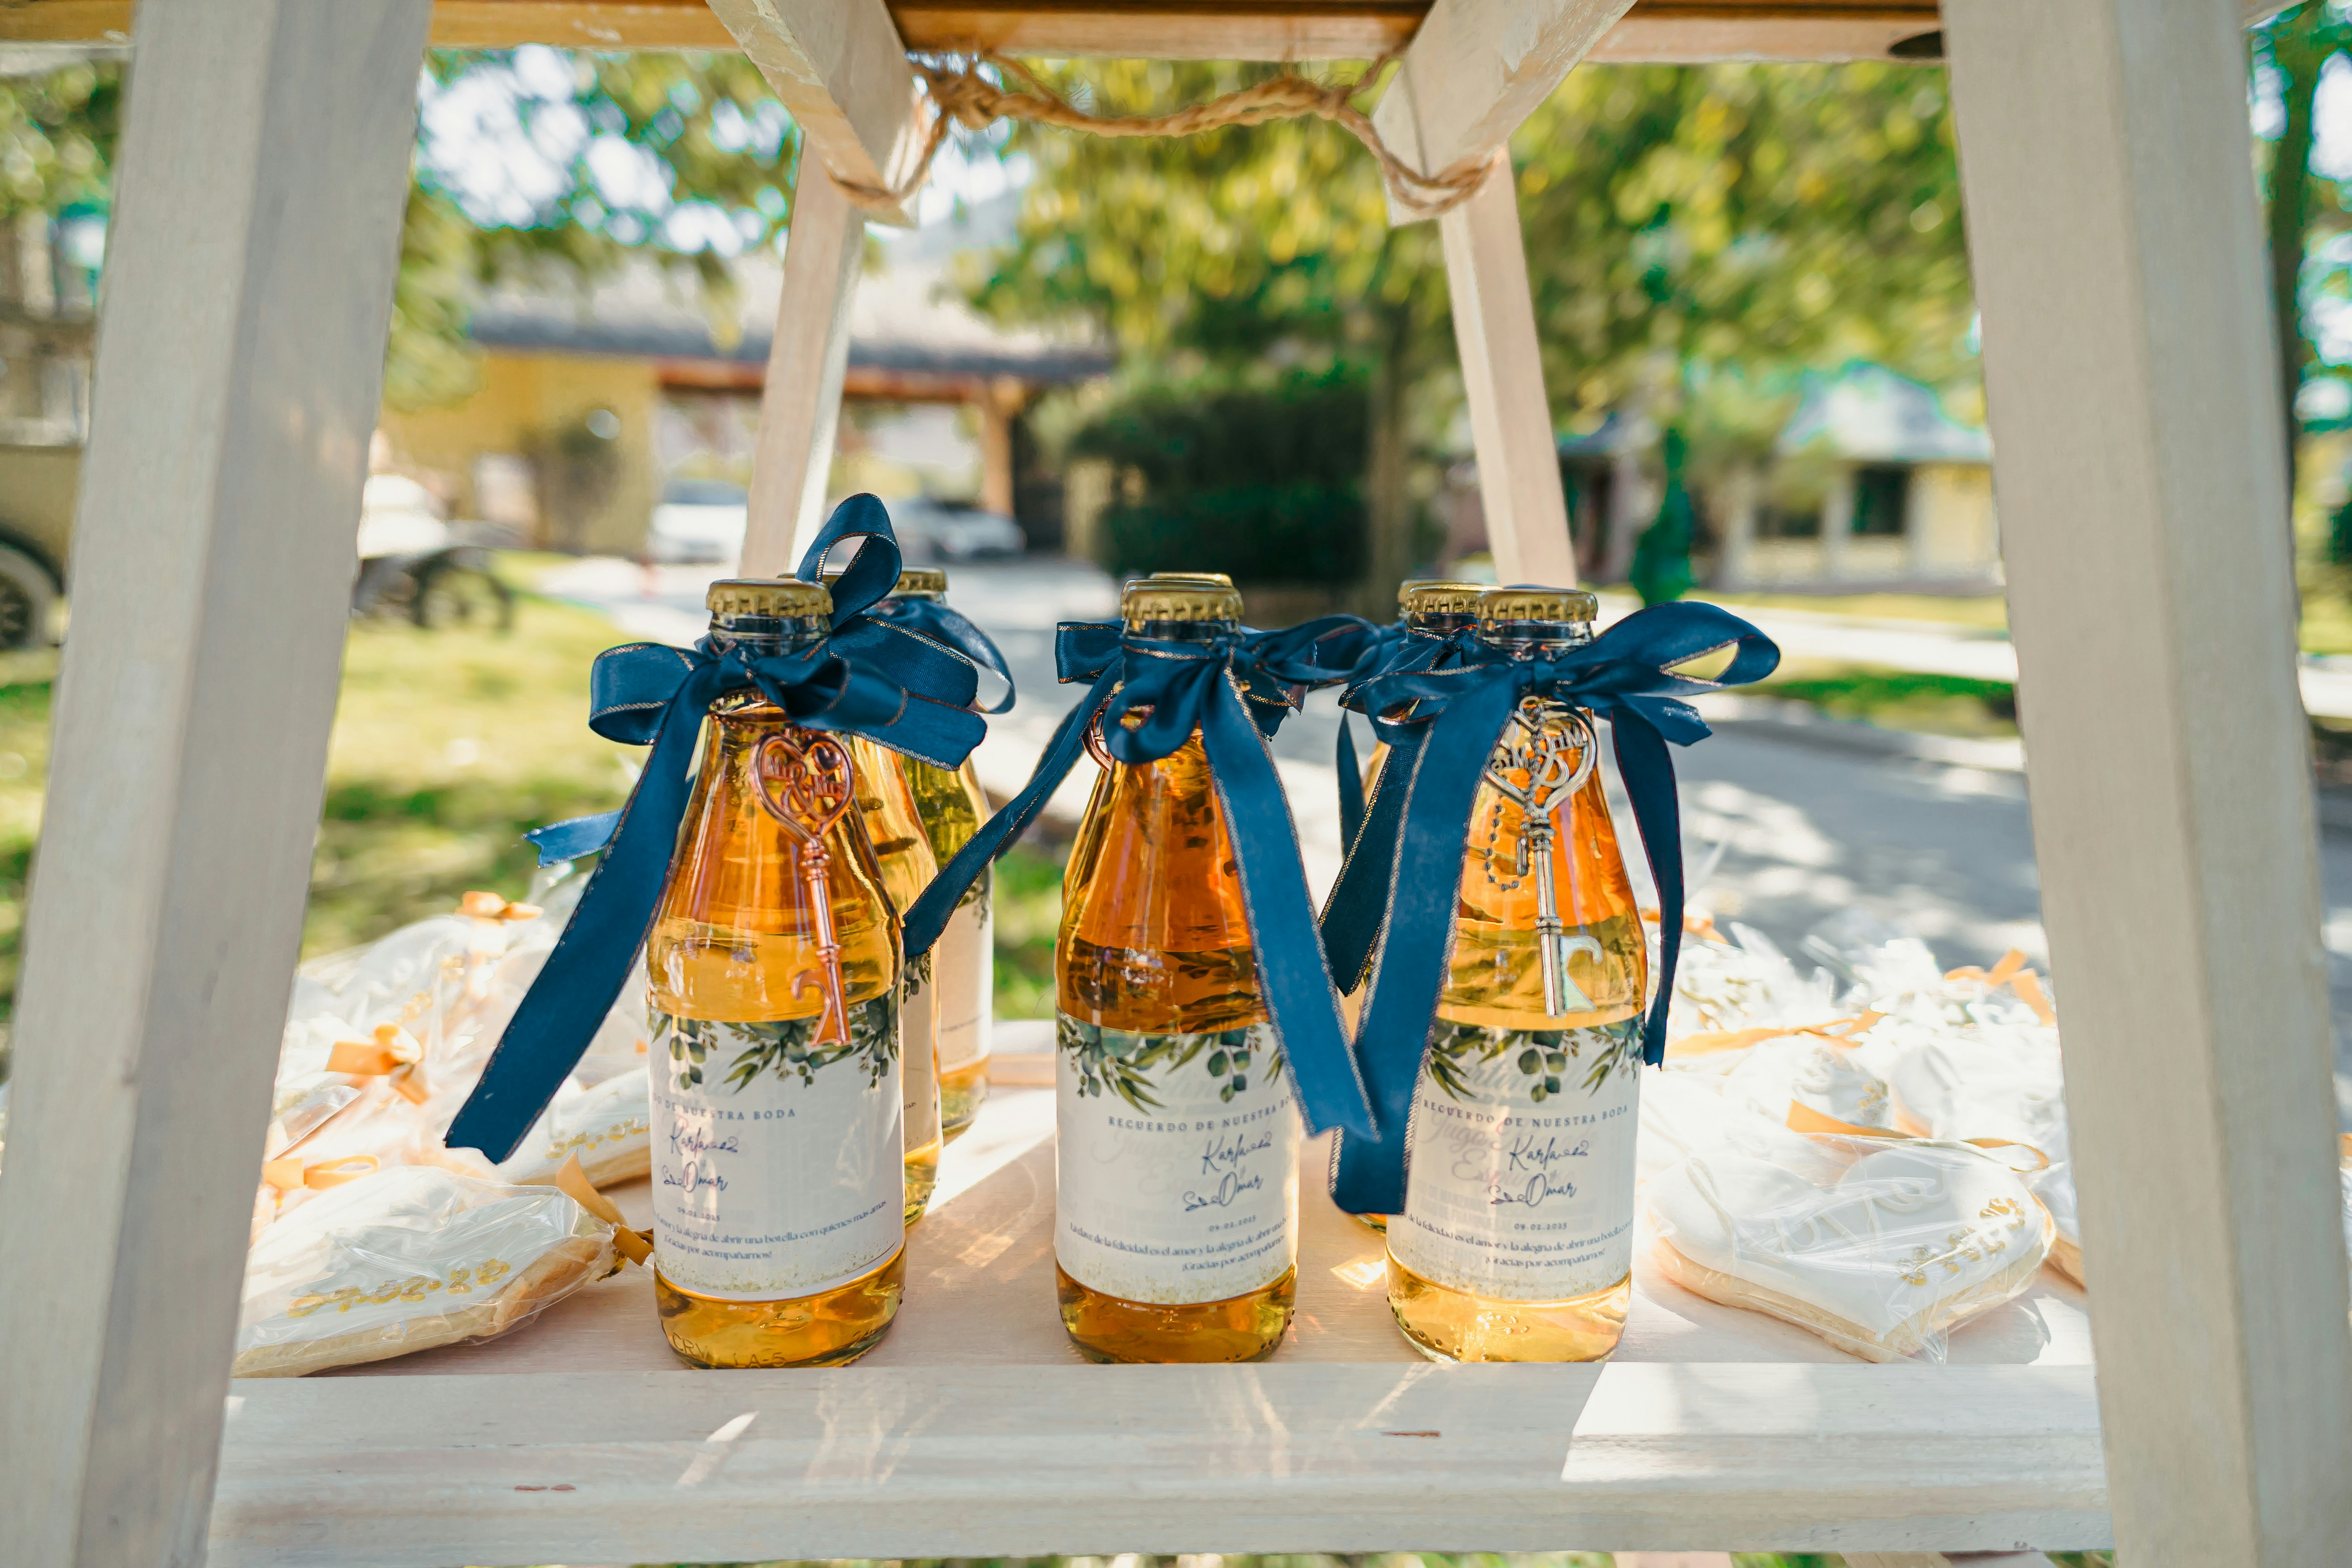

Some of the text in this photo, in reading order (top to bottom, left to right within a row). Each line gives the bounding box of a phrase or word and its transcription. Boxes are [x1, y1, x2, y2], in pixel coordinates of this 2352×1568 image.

[683, 1105, 744, 1120] NUESTRA
[753, 1108, 796, 1120] BODA
[1109, 1115, 1188, 1132] RECUERDO
[1195, 1120, 1215, 1131] DE
[1222, 1104, 1277, 1127] NUESTRA
[1424, 1099, 1628, 1128] RECUERDO DE NUESTRA BODA
[764, 1230, 798, 1244] botella
[799, 1229, 819, 1240] con
